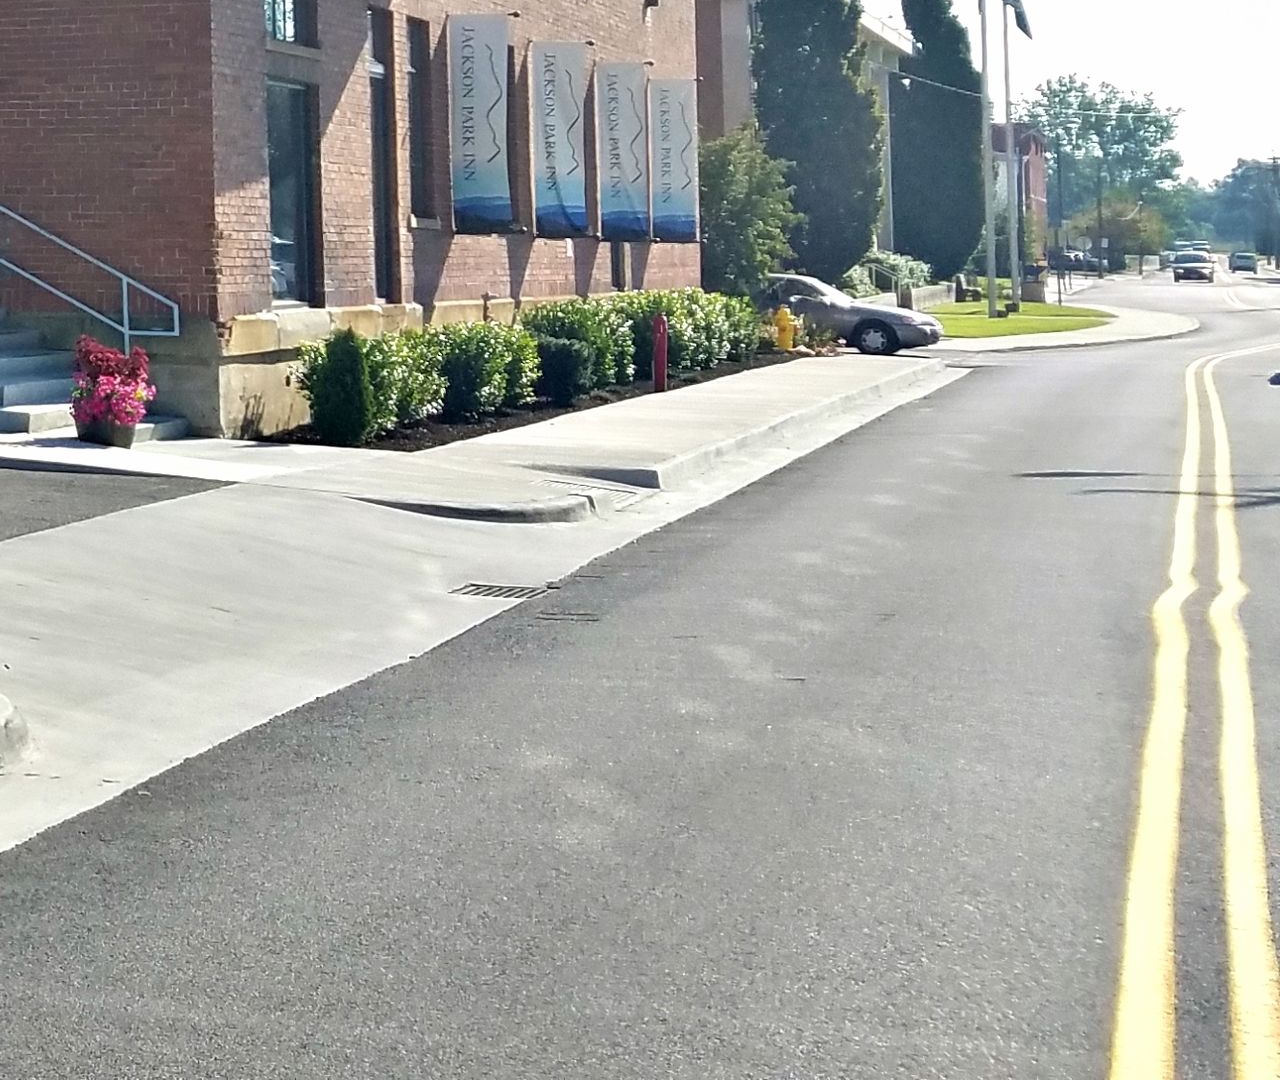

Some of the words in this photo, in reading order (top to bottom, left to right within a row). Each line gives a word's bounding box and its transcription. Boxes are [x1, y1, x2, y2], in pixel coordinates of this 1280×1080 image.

[461, 26, 475, 98] JACKSON
[544, 52, 556, 117] JACKSON
[607, 73, 620, 132] JACKSON
[659, 88, 671, 142] JACKSON
[461, 106, 475, 146] PARK
[544, 124, 556, 160] PARK
[463, 153, 477, 181] INN
[609, 137, 621, 171] PARK
[661, 147, 671, 177] PARK
[545, 165, 557, 191] INN
[610, 175, 621, 199] INN
[662, 182, 672, 204] INN
